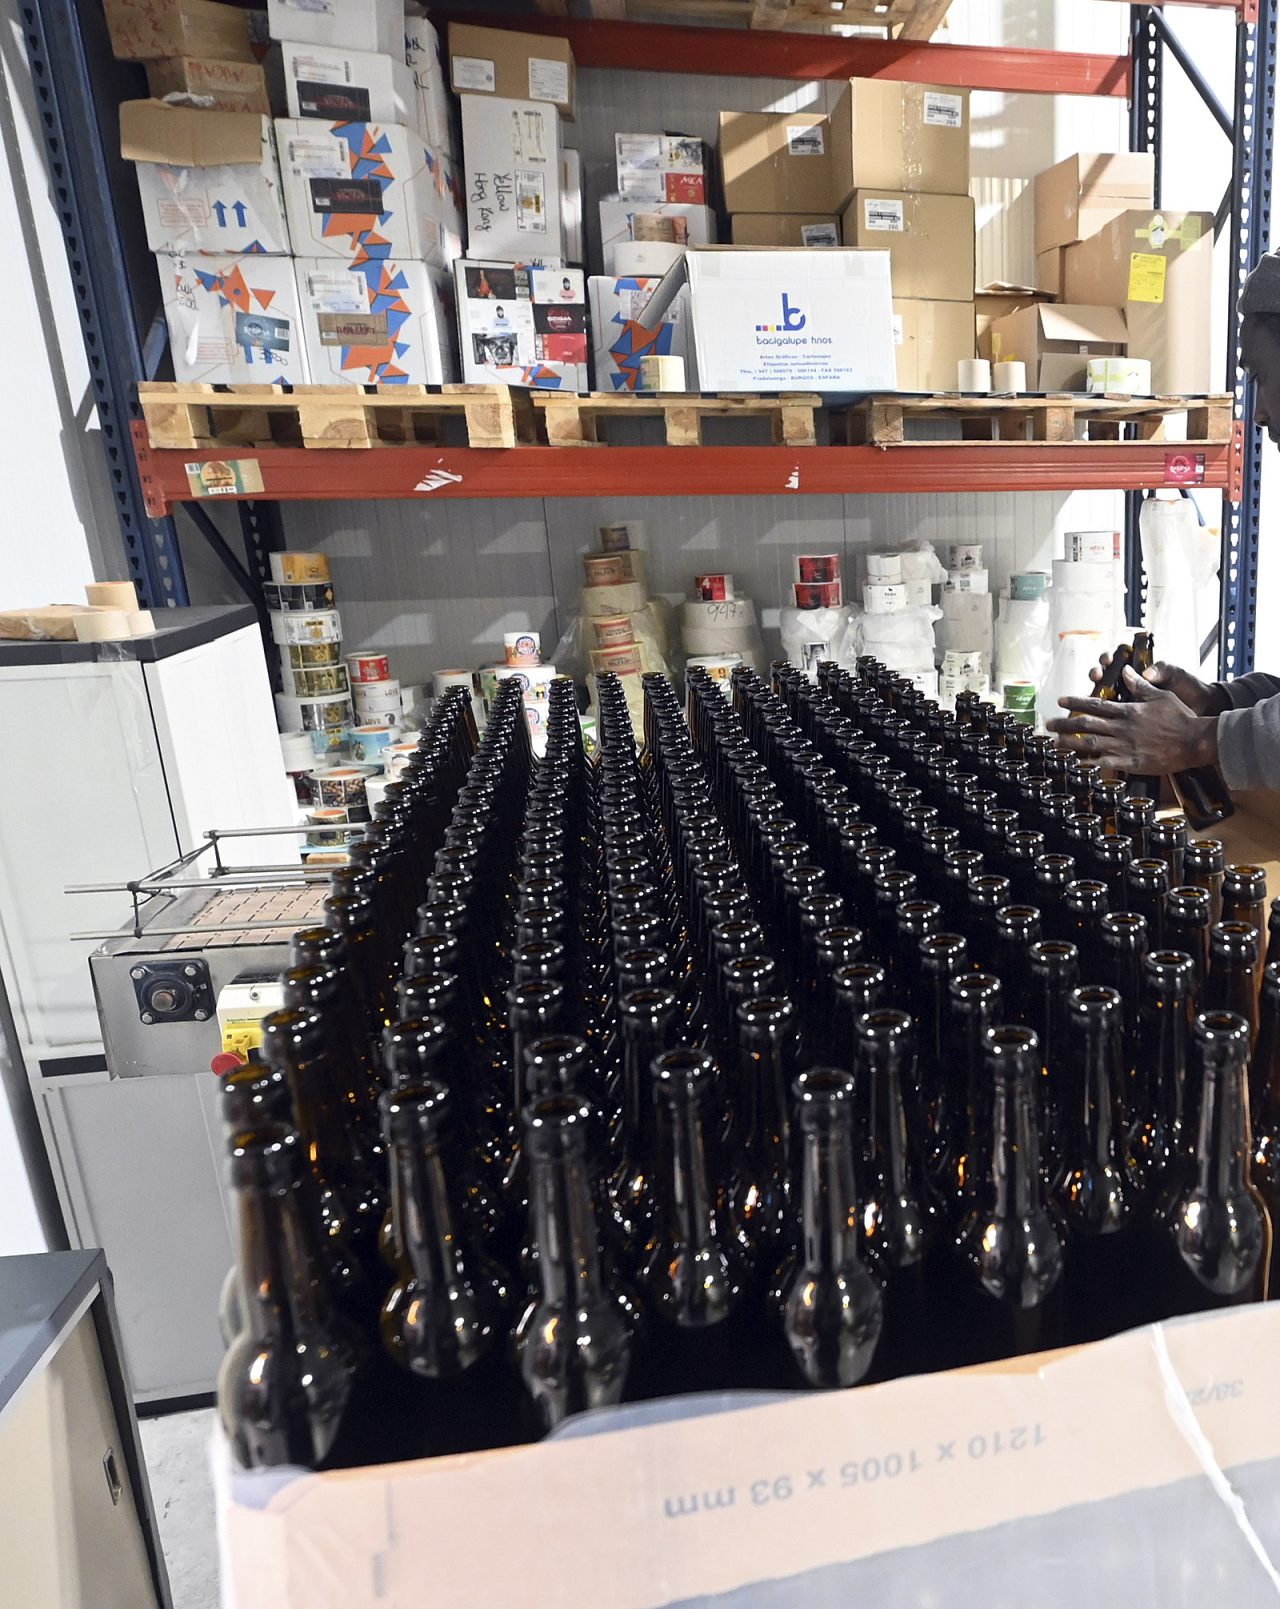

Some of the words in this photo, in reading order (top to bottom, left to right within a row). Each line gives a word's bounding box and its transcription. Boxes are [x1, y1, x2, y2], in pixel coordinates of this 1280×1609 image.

[493, 173, 513, 212] Yellow
[938, 1441, 956, 1461] x
[968, 1423, 1047, 1460] 1210
[806, 1469, 827, 1490] x
[840, 1453, 923, 1488] 1005
[663, 1486, 736, 1519] mm
[751, 1479, 794, 1507] 93
